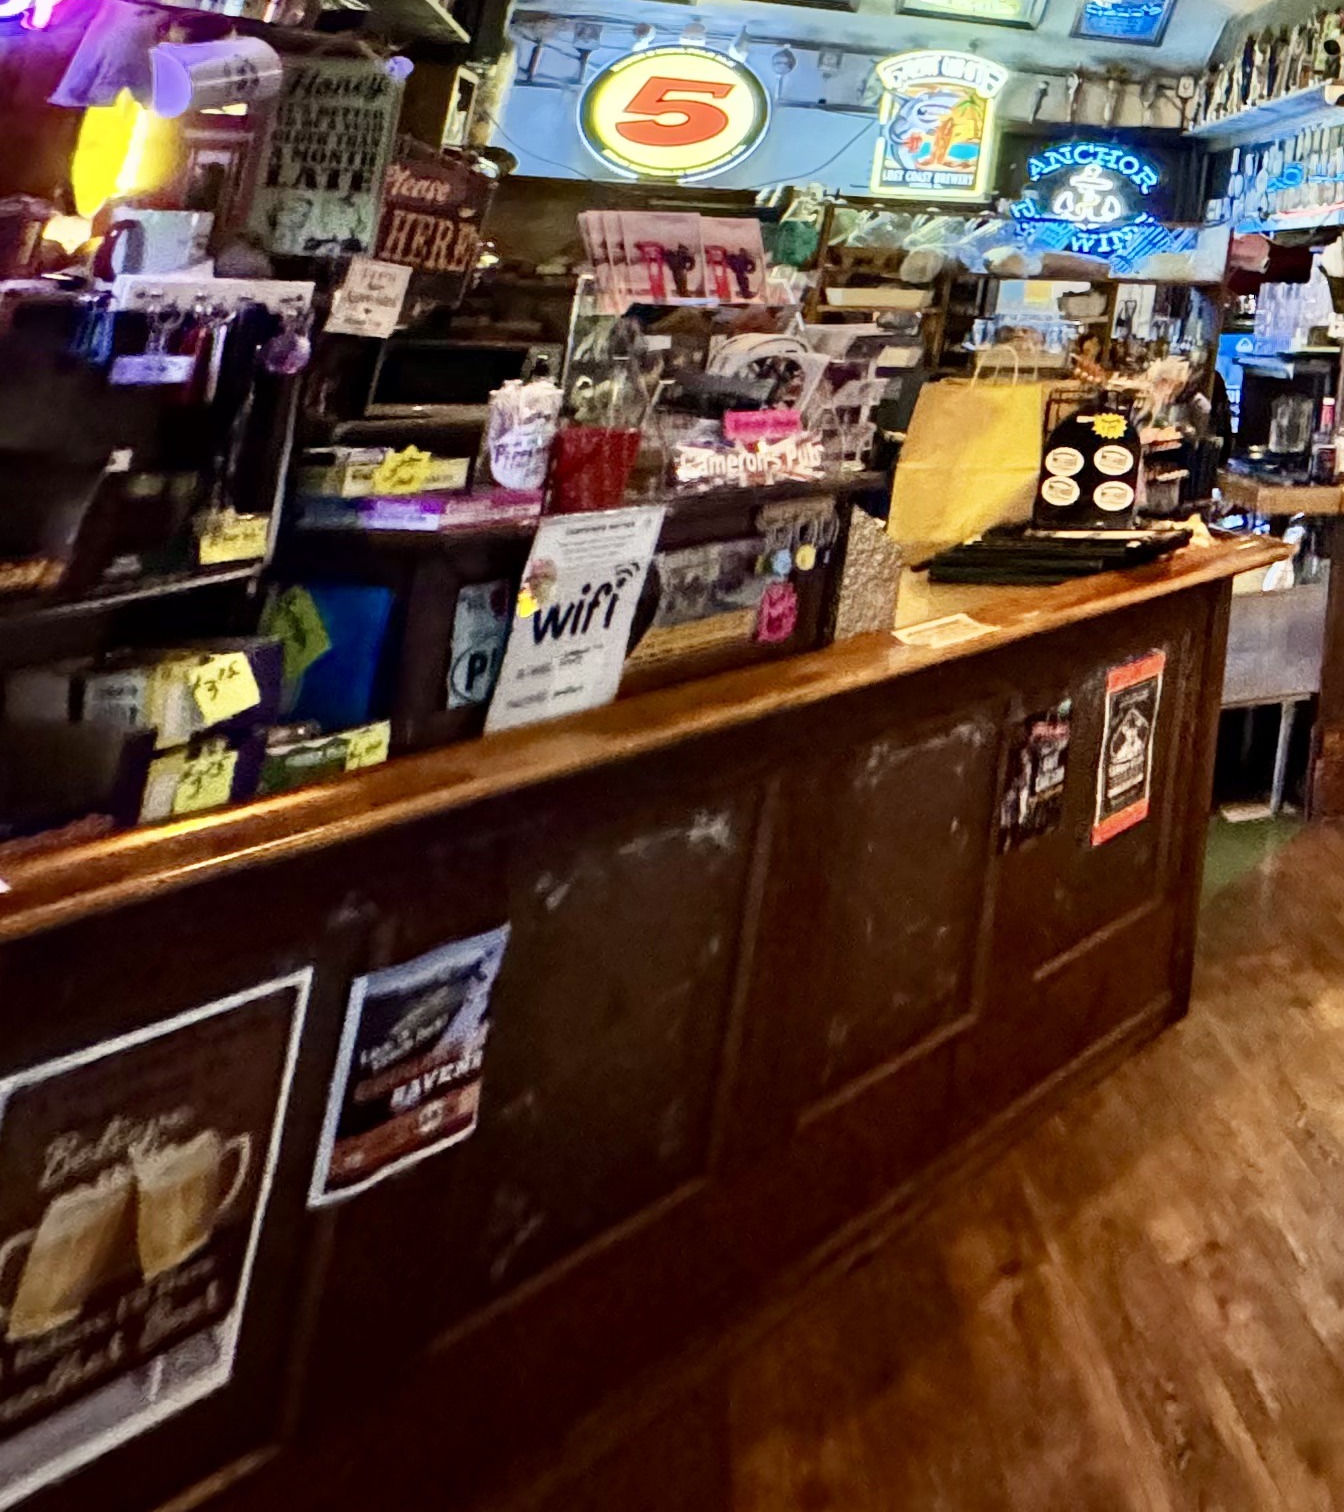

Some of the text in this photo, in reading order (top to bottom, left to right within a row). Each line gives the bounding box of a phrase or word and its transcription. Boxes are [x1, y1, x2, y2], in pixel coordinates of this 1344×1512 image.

[615, 76, 736, 148] 5
[882, 169, 904, 182] LOST
[905, 170, 933, 184] COAST
[1027, 141, 1160, 195] ANCHOR
[377, 209, 479, 273] HERE
[533, 576, 628, 645] wifi
